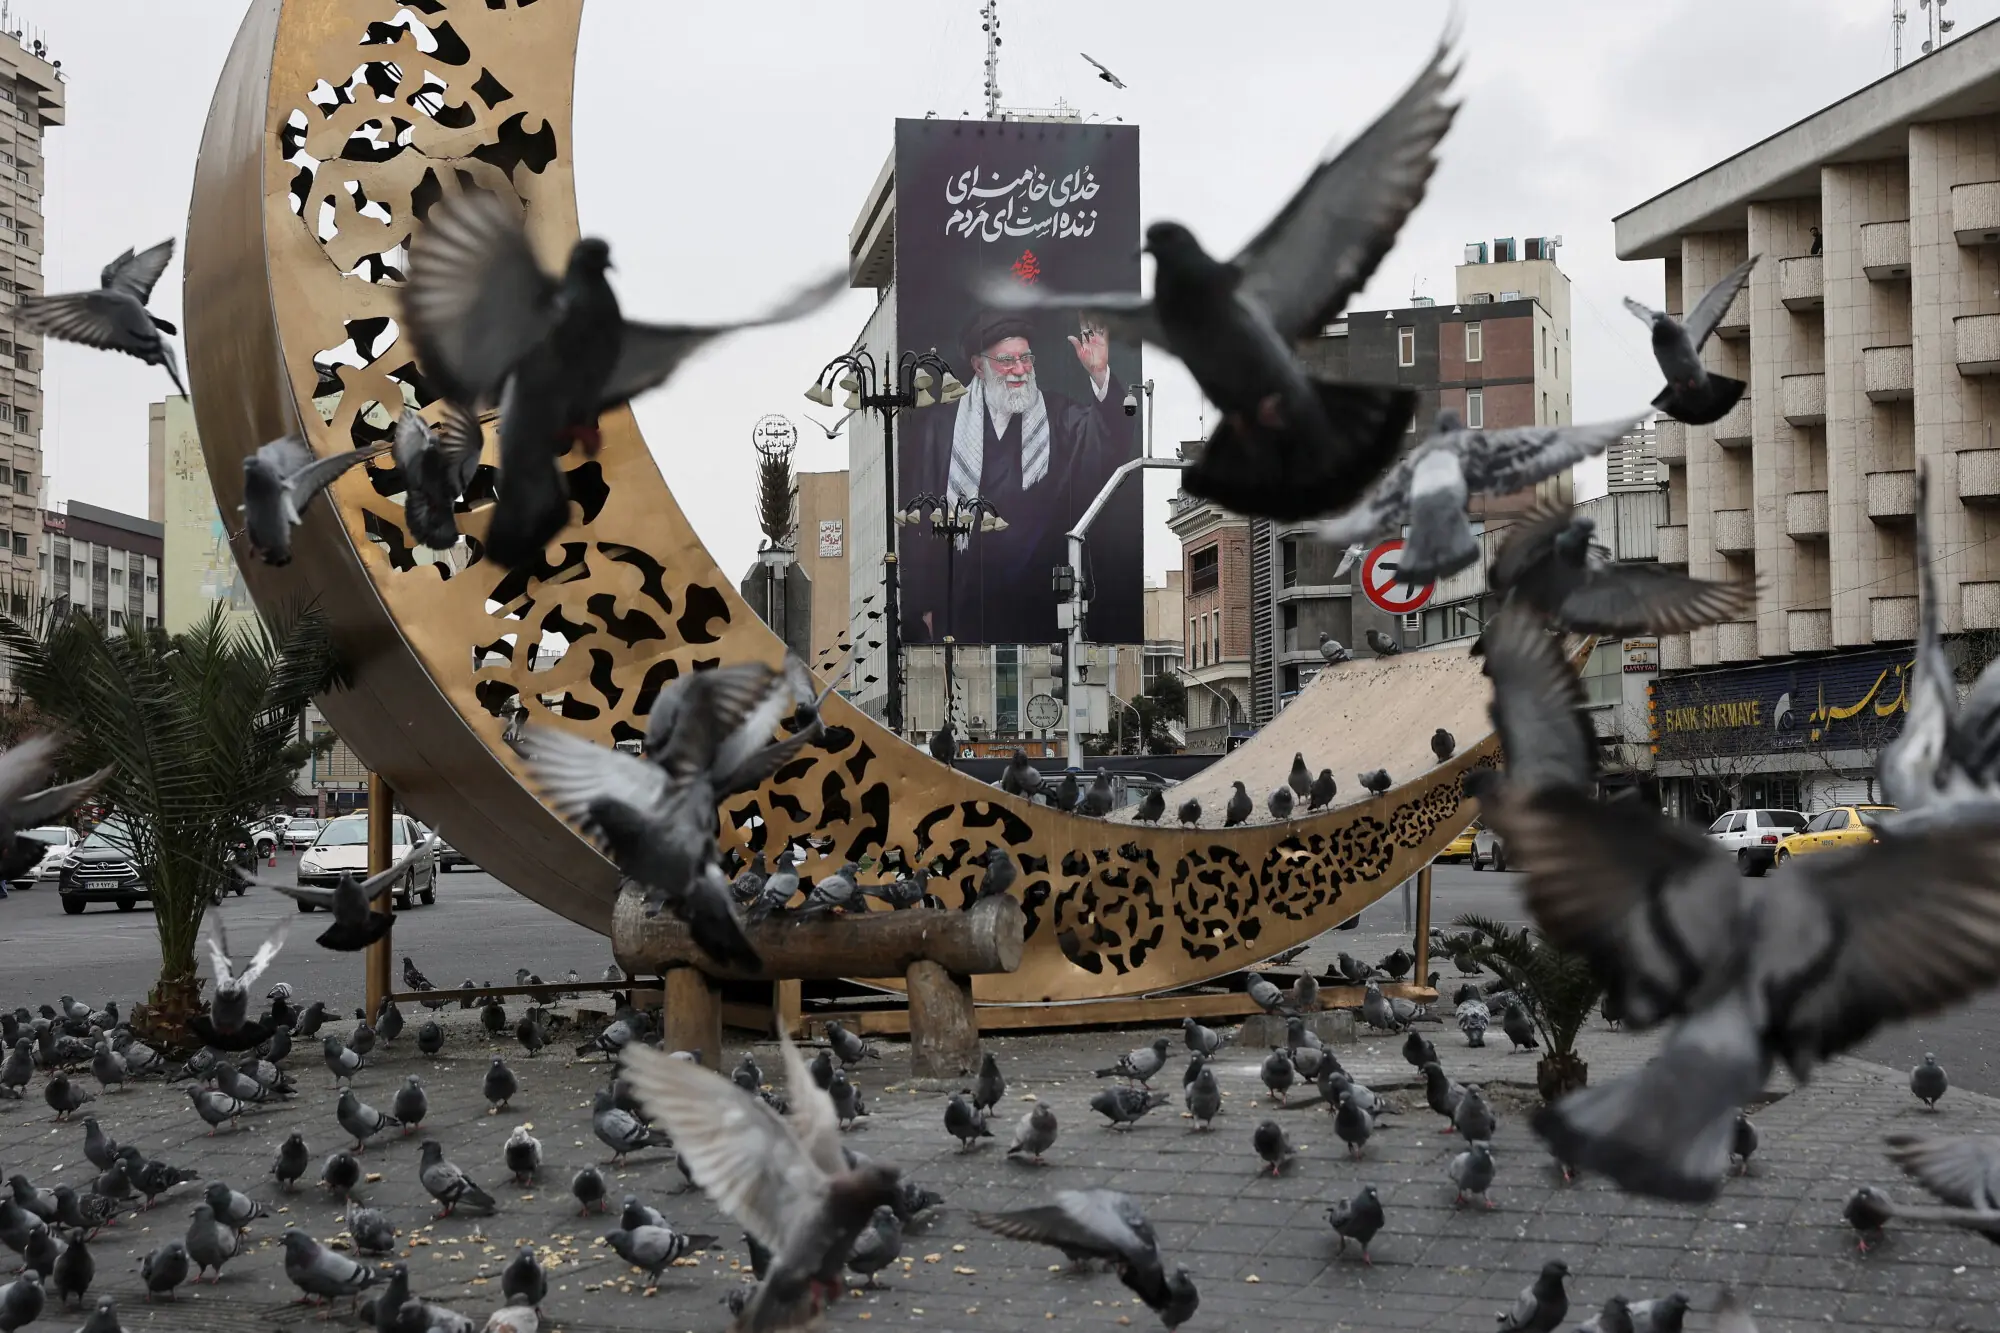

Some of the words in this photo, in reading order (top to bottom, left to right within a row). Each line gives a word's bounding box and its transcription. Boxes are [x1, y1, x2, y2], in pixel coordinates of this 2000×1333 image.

[1059, 210, 1098, 239] زنده
[1623, 640, 1657, 651] مسکن
[1665, 706, 1700, 732] BANK
[1703, 700, 1761, 729] SARMAYE
